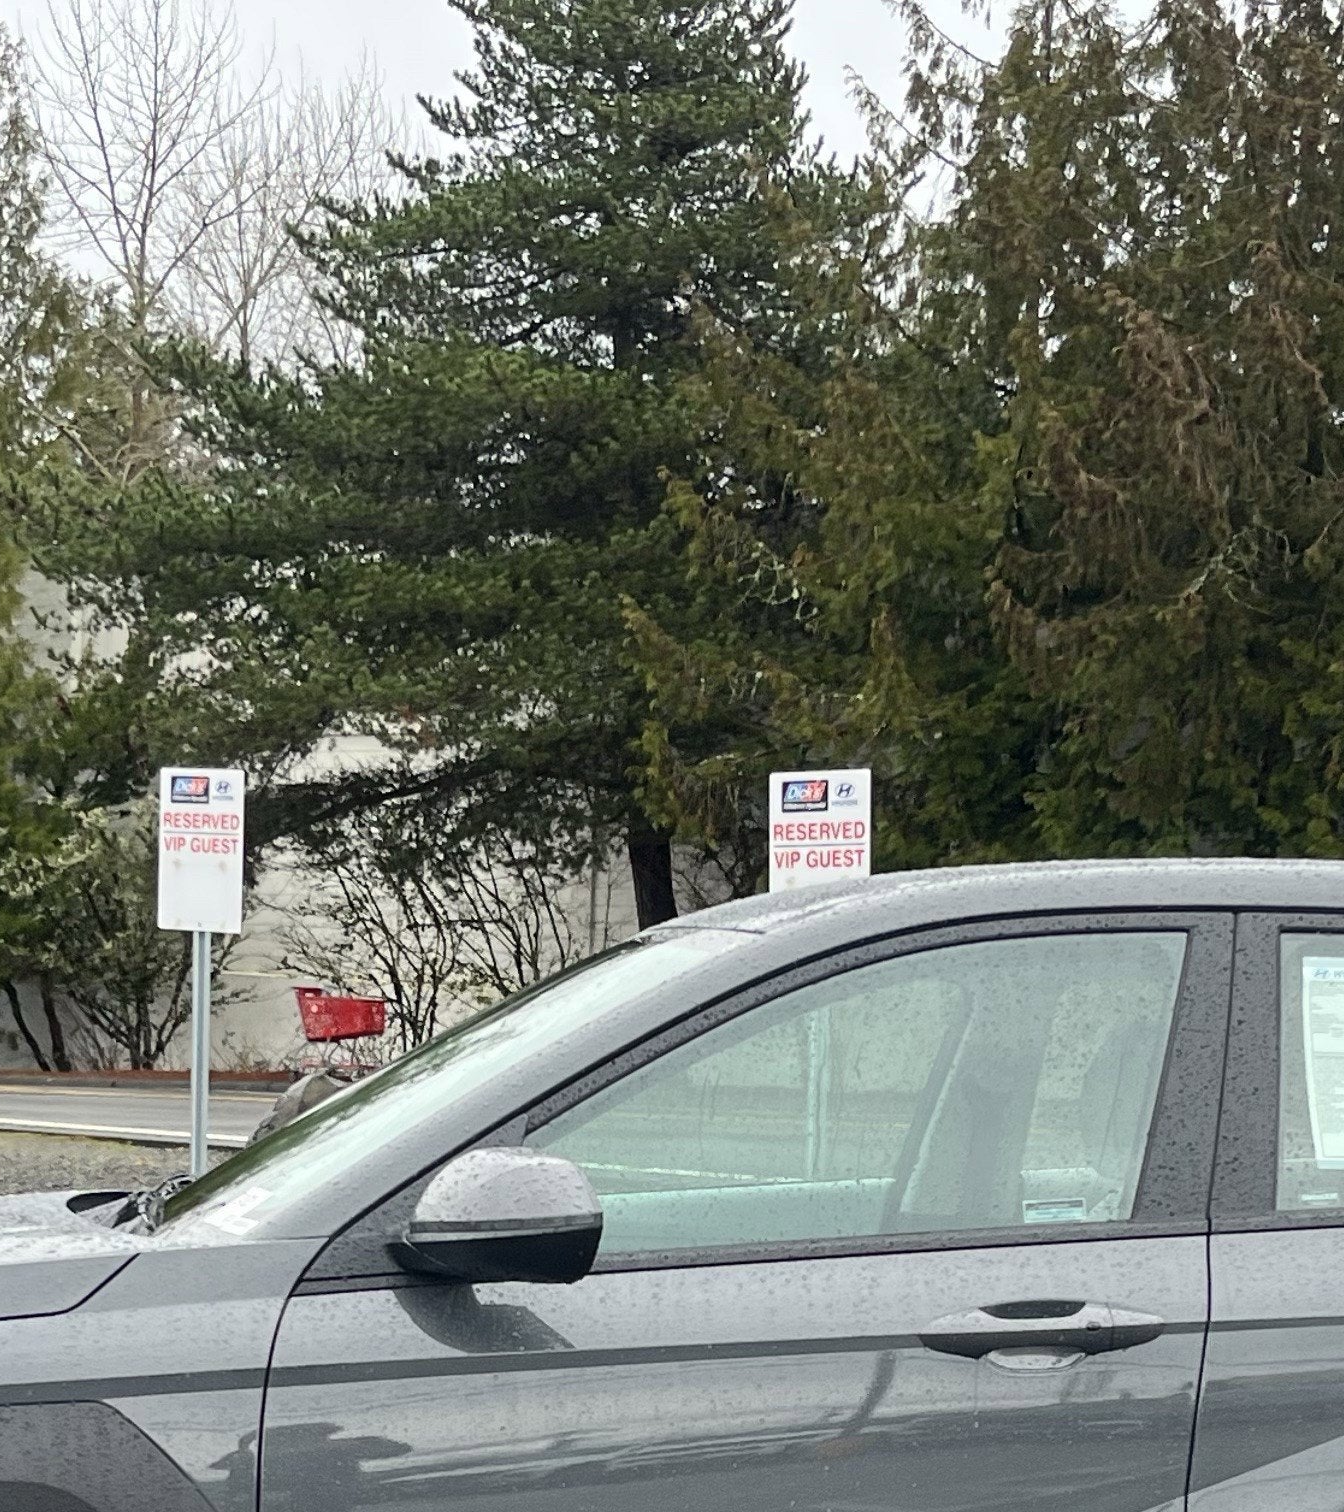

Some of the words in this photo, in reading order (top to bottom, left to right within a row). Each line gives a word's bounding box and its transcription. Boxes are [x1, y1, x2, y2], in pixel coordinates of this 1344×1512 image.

[163, 812, 240, 830] RESERVED
[773, 821, 866, 841] RESERVED
[164, 836, 186, 851] VIP
[190, 837, 239, 855] GUEST
[774, 851, 801, 869] VIP
[806, 850, 865, 868] GUEST
